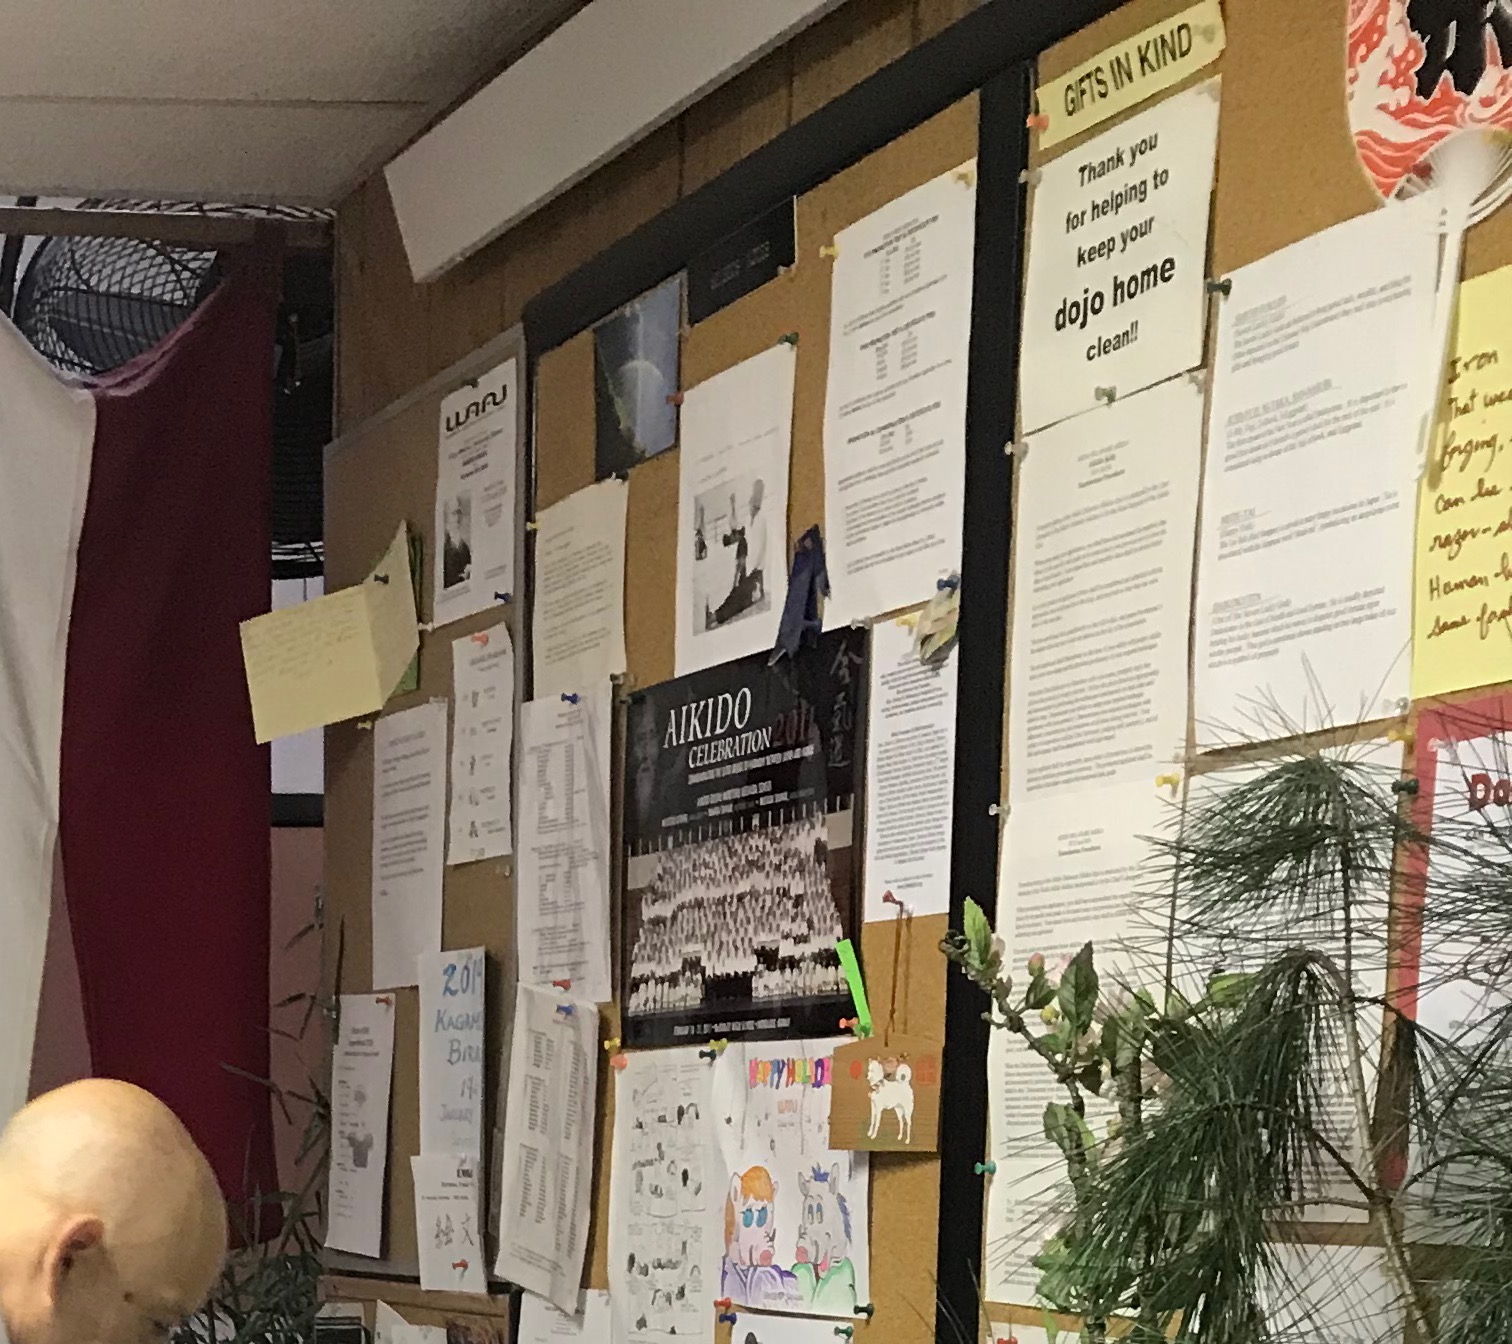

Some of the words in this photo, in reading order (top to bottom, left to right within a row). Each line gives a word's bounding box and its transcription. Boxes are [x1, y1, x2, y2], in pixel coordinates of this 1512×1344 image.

[1064, 65, 1109, 117] GIFTS
[1109, 51, 1134, 91] IN
[1137, 23, 1193, 77] KIND
[1078, 146, 1125, 187] Thank
[1129, 132, 1159, 168] you
[1066, 209, 1087, 234] for
[1091, 178, 1148, 222] helping
[1153, 168, 1169, 190] to
[1077, 236, 1116, 268] keep
[1120, 216, 1156, 254] your
[1055, 287, 1105, 332] dojo
[1112, 256, 1176, 307] home
[1086, 320, 1139, 362] clean!!
[663, 687, 752, 748] AIKIDO
[688, 726, 772, 768] CELEBRATION
